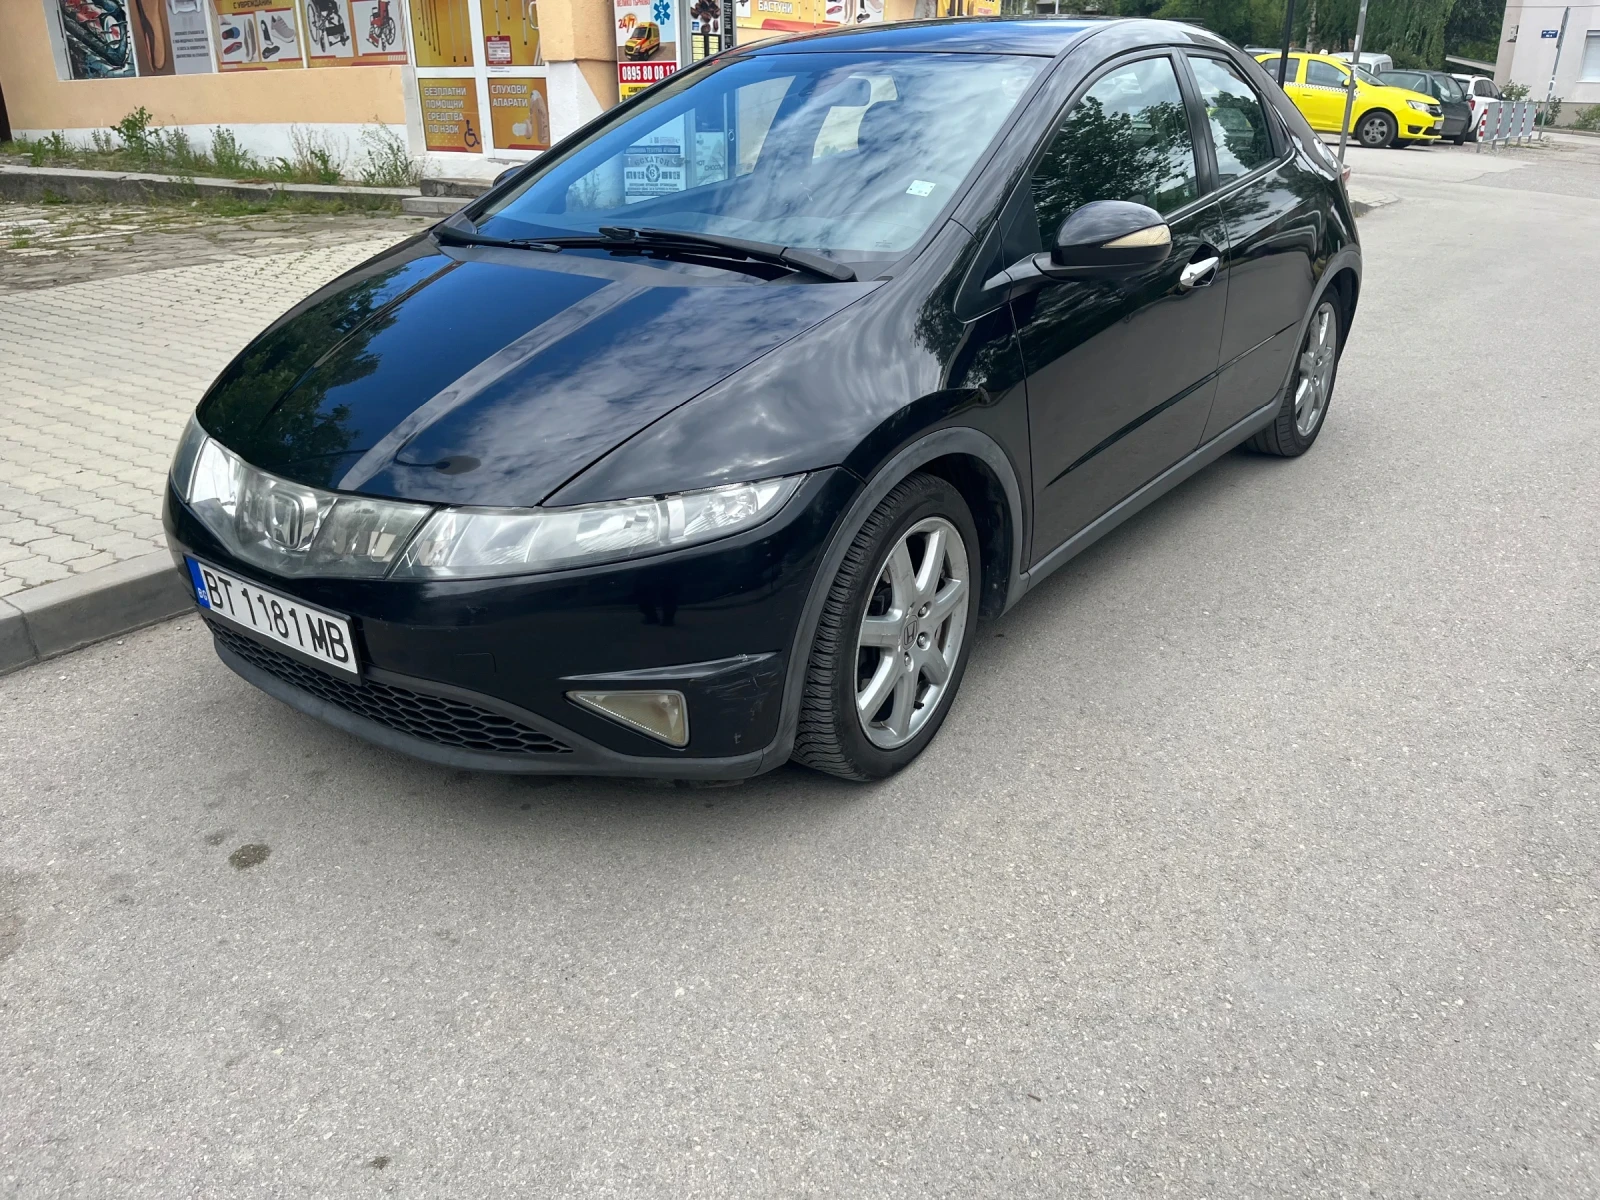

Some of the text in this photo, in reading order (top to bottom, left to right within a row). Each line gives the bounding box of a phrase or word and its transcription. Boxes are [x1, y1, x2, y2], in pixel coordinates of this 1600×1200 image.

[758, 0, 793, 14] БАСТУНИ
[622, 65, 641, 80] 0895
[643, 65, 653, 80] 80
[654, 65, 664, 80] 08
[424, 87, 467, 96] БЕЗПЛАТНИ
[491, 84, 528, 94] СЛУХОВИ
[425, 99, 464, 109] ПОМОЩНИ
[492, 98, 528, 107] АПАРАТИ
[427, 112, 464, 121] СРЕДСТВА
[428, 124, 459, 133] ПО НЗОК
[203, 569, 349, 663] BT 1181 MB
